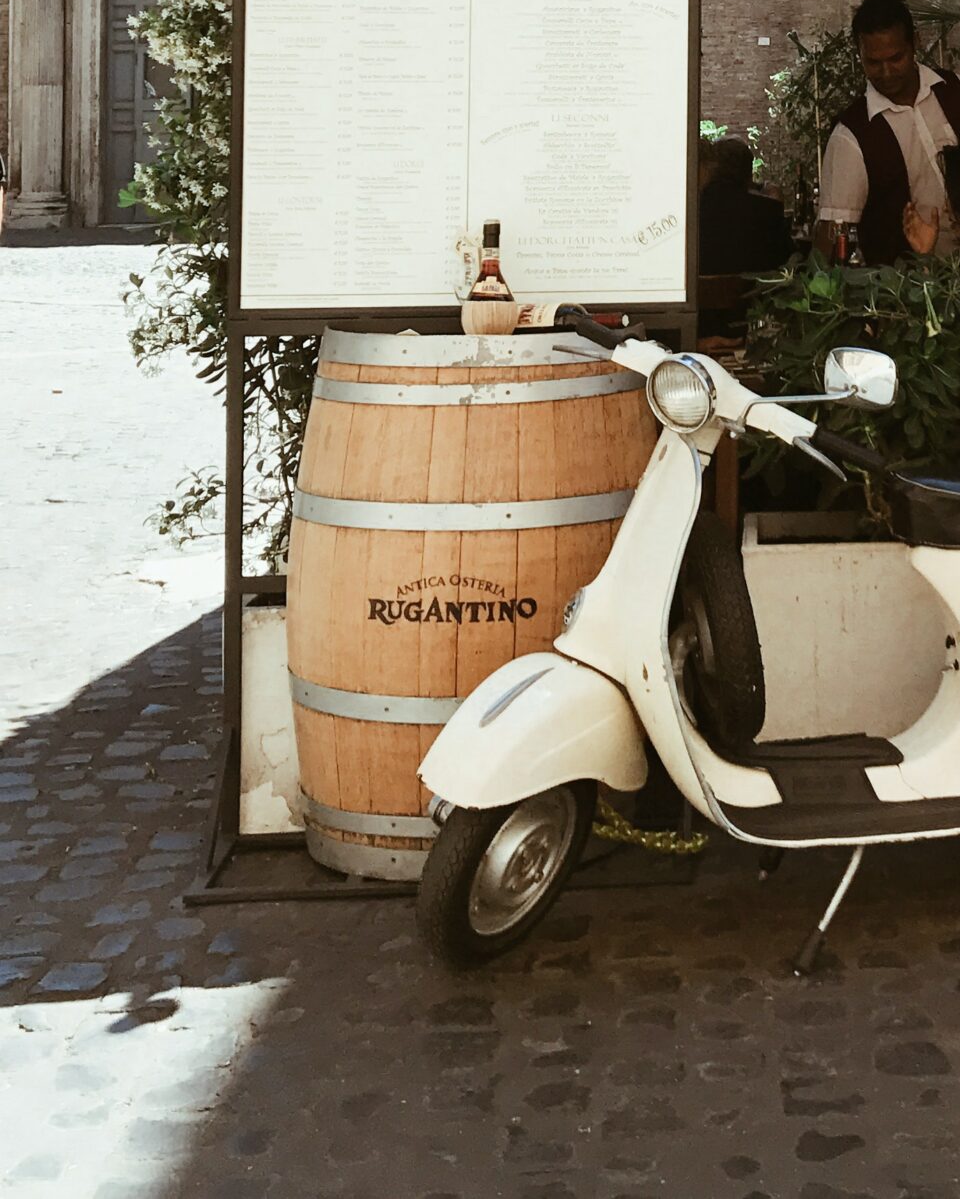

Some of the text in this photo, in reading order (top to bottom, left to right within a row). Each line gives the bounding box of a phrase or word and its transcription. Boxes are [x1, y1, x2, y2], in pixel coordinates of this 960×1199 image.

[396, 574, 506, 599] ANTICA OSTERIA
[367, 596, 538, 625] RUGANTINO
